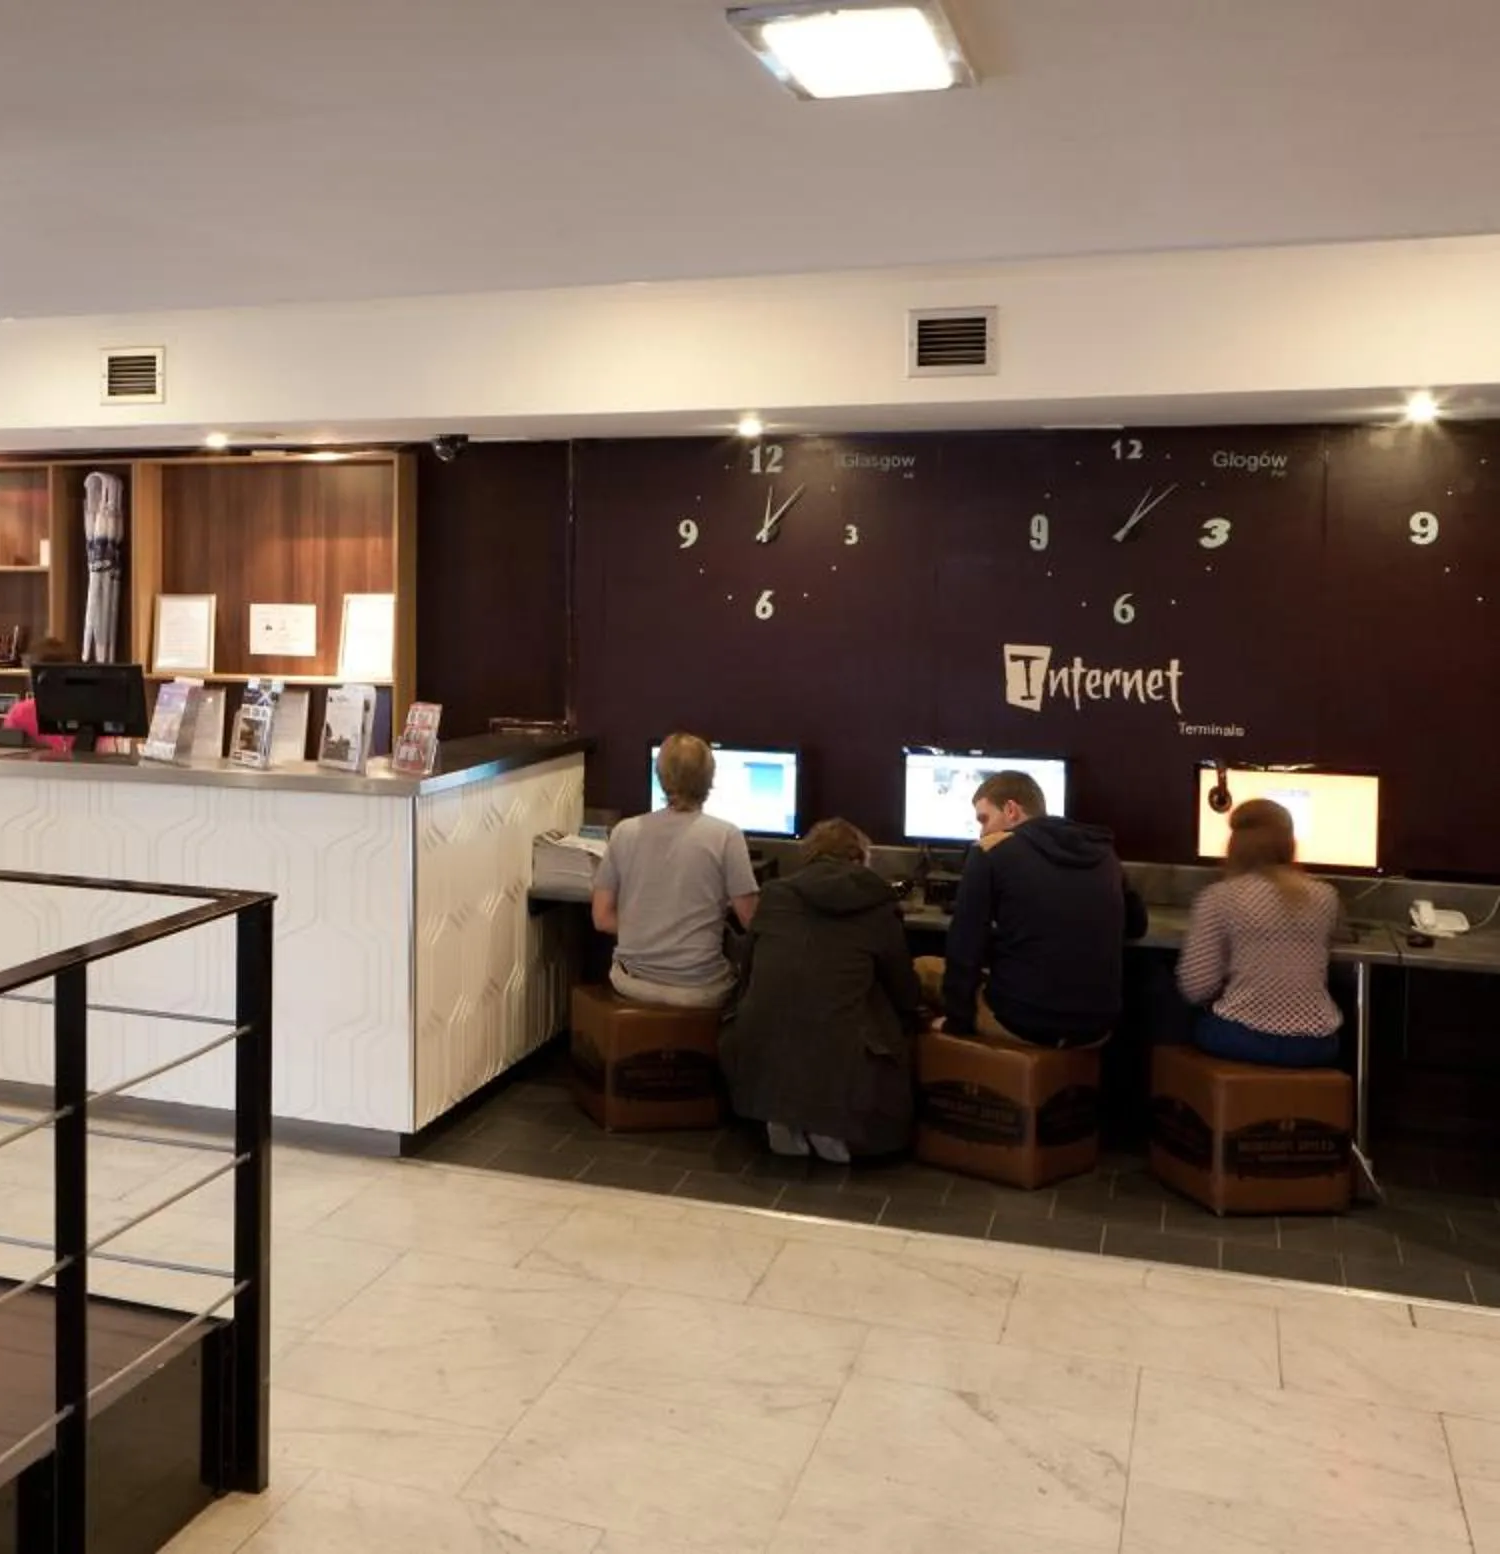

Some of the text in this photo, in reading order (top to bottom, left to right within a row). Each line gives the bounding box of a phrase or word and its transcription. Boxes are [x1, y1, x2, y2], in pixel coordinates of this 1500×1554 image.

[748, 445, 784, 474] 12
[840, 452, 916, 472] Glasgow
[1111, 439, 1143, 460] 12
[1211, 450, 1288, 473] Glogów
[678, 519, 699, 549] 9
[844, 524, 859, 545] 3
[1029, 514, 1050, 551] 9
[1199, 517, 1232, 548] 3
[1409, 511, 1439, 545] 9
[755, 590, 775, 620] 6
[1113, 594, 1136, 624] 6
[1004, 644, 1183, 713] Internet
[1179, 720, 1245, 738] Terminals
